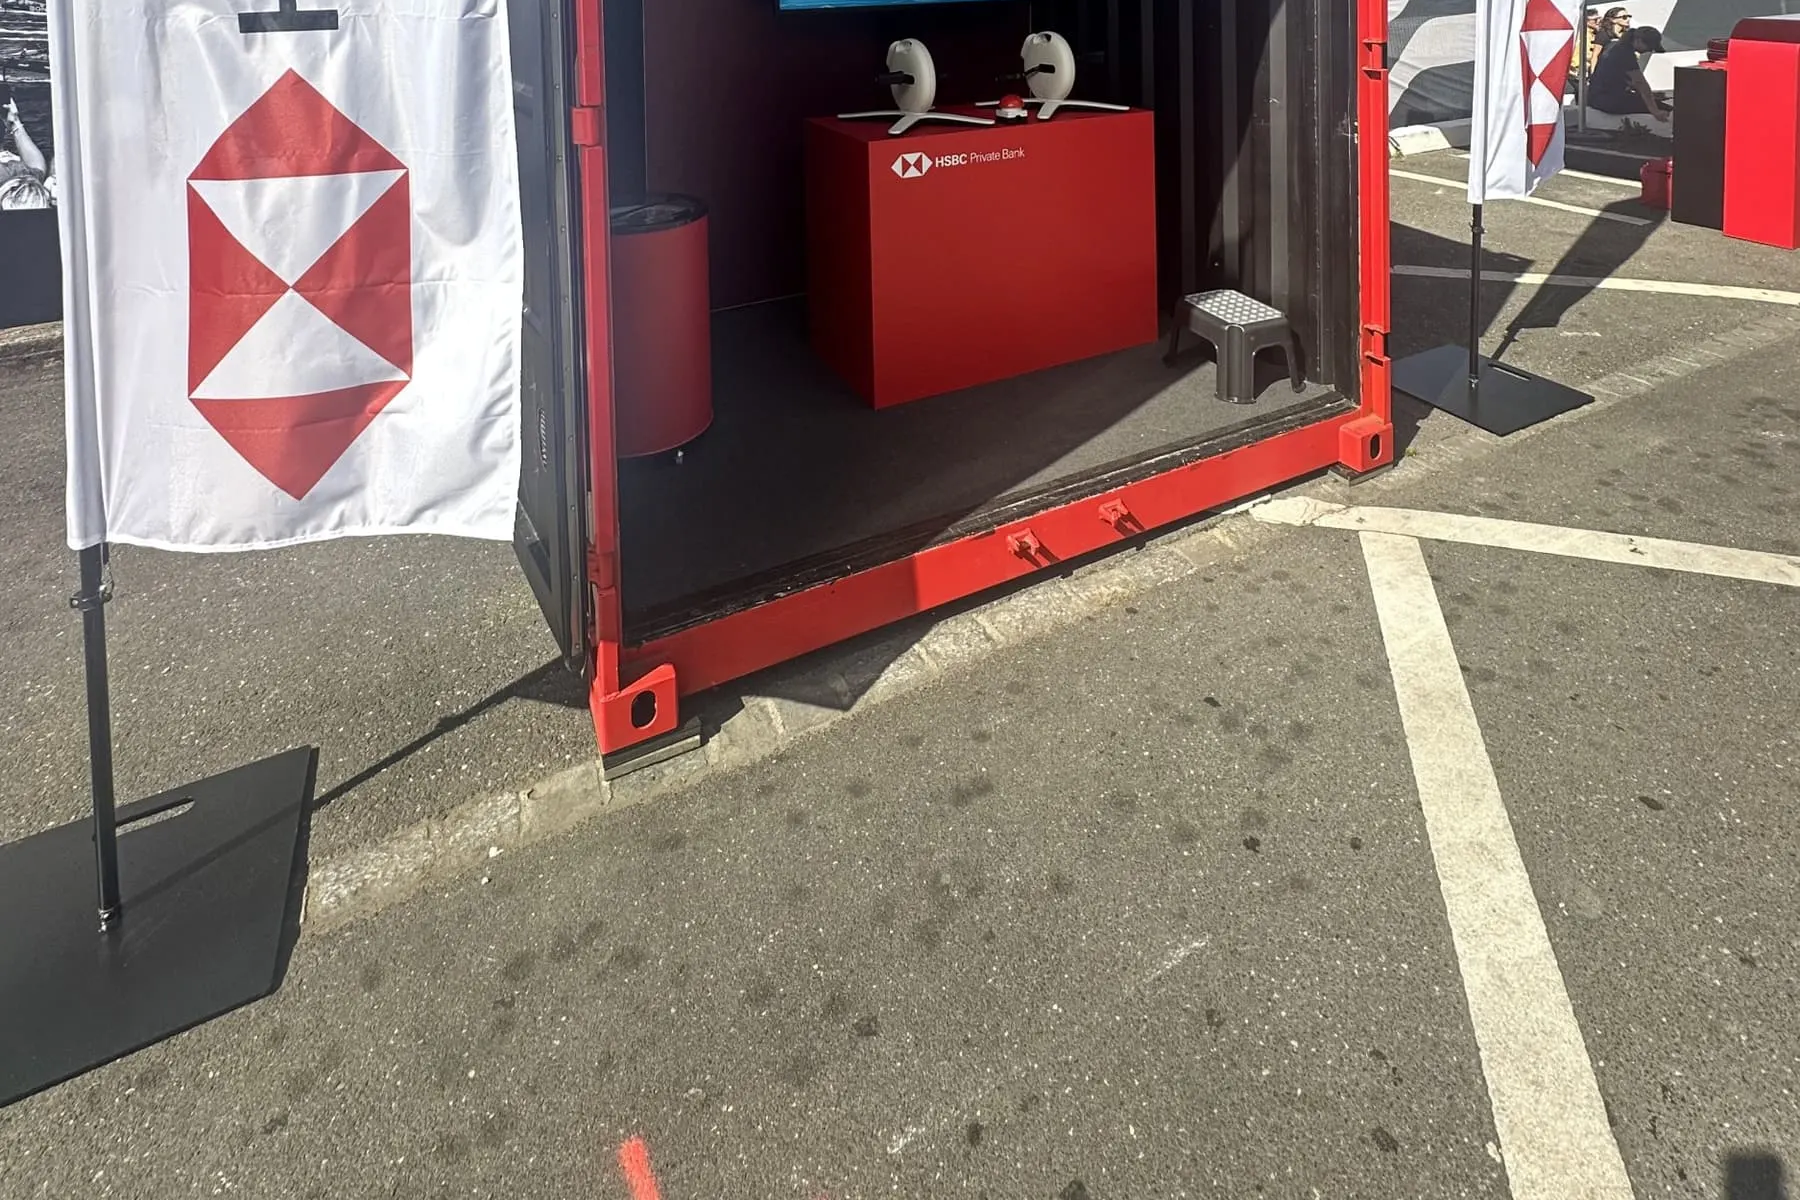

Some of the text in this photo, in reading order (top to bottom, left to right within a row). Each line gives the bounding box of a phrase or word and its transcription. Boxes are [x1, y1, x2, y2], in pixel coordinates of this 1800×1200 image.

[935, 146, 1026, 168] HSBC Private Bank
